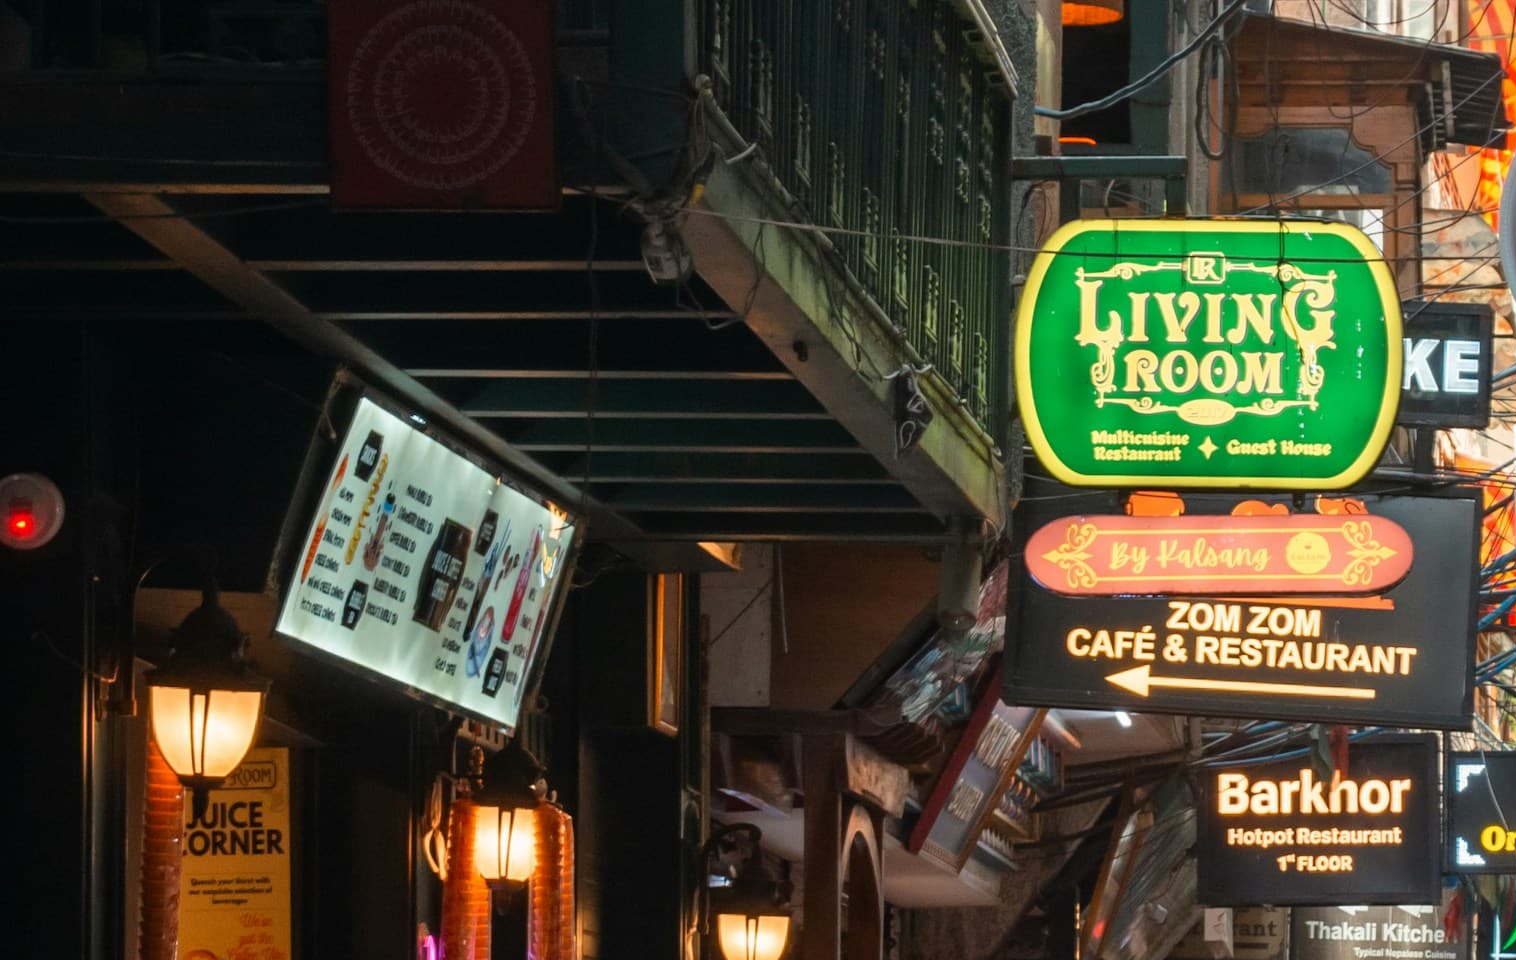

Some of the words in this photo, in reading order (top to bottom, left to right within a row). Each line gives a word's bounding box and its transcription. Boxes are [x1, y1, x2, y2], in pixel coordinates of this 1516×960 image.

[1074, 276, 1336, 350] LIVING
[1123, 350, 1285, 394] ROOM
[1091, 430, 1190, 446] Multicuisine
[1226, 438, 1277, 455] Guest
[1280, 440, 1332, 456] House
[1094, 446, 1182, 462] Restaurant
[1109, 541, 1149, 574] By
[1166, 602, 1242, 633] ZOM
[1246, 607, 1321, 637] ZOM
[1066, 625, 1156, 660] CAFÉ
[1162, 634, 1188, 663] &
[1195, 635, 1417, 676] RESTAURANT
[1217, 769, 1411, 816] Barkhor
[183, 829, 285, 857] ORNER
[1227, 826, 1294, 848] Hotpot
[1296, 825, 1402, 846] Restaurant
[1298, 854, 1354, 873] FLOOR
[1305, 920, 1376, 942] Thakali
[1382, 922, 1458, 944] Kitche
